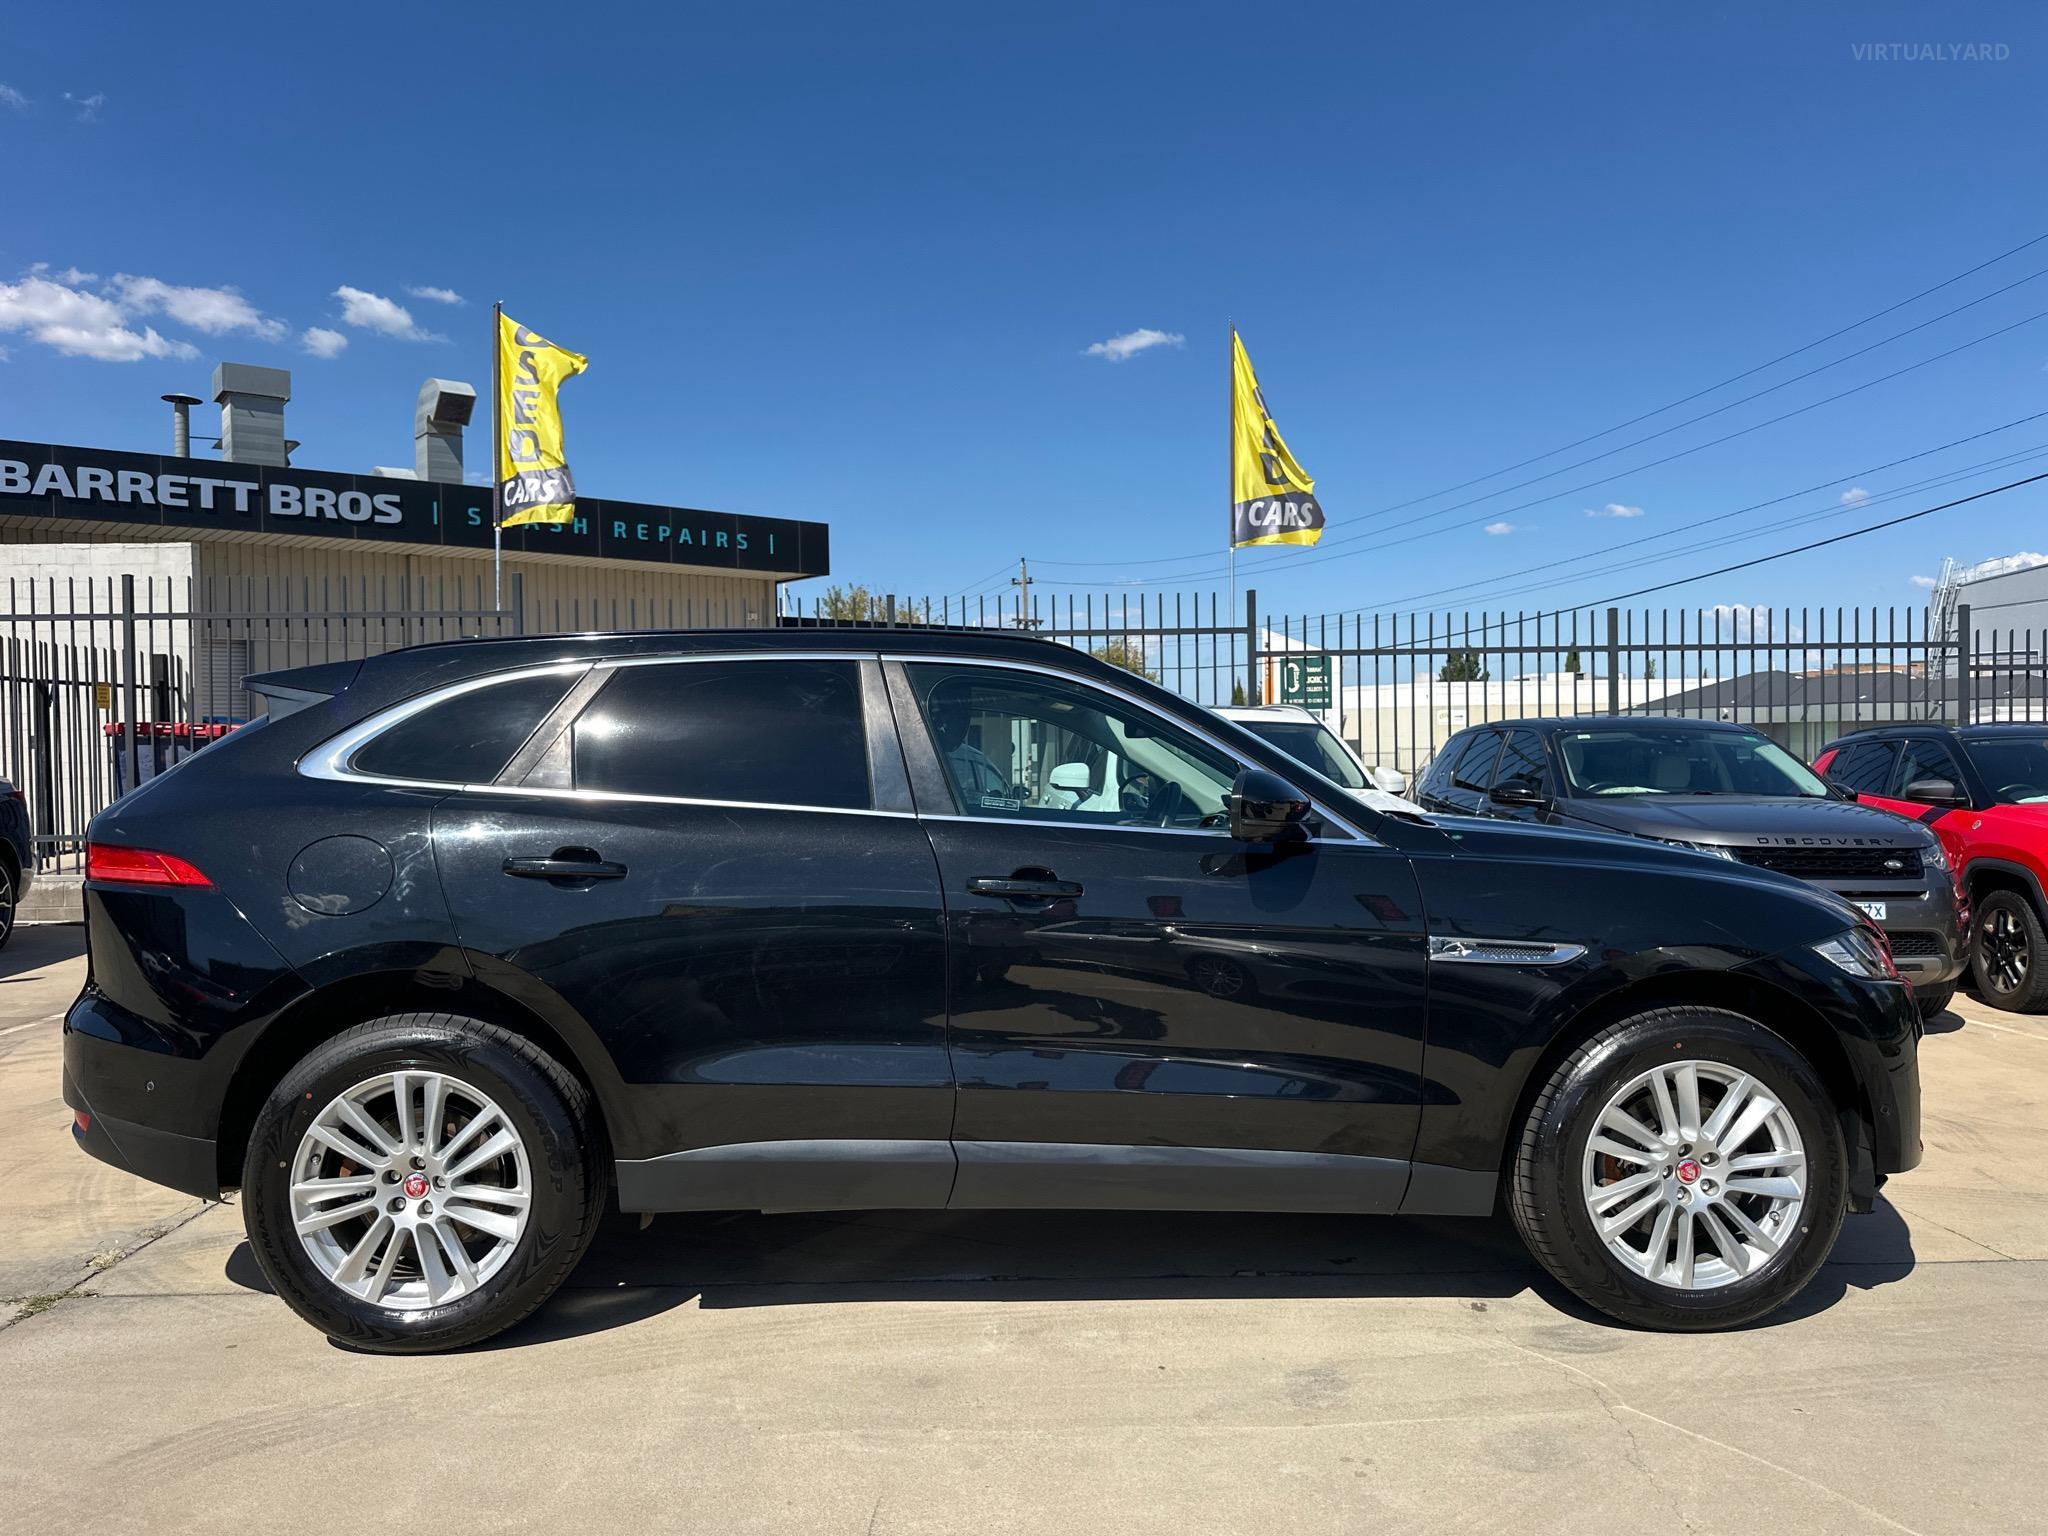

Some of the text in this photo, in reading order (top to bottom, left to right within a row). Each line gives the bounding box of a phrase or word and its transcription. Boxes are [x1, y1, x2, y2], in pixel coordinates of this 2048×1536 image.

[0, 459, 403, 525] BARRETT BROS
[504, 477, 559, 507] CARS
[1248, 500, 1313, 527] CARS
[613, 520, 748, 550] REPAIRS
[1756, 837, 1895, 846] DISCOVERY
